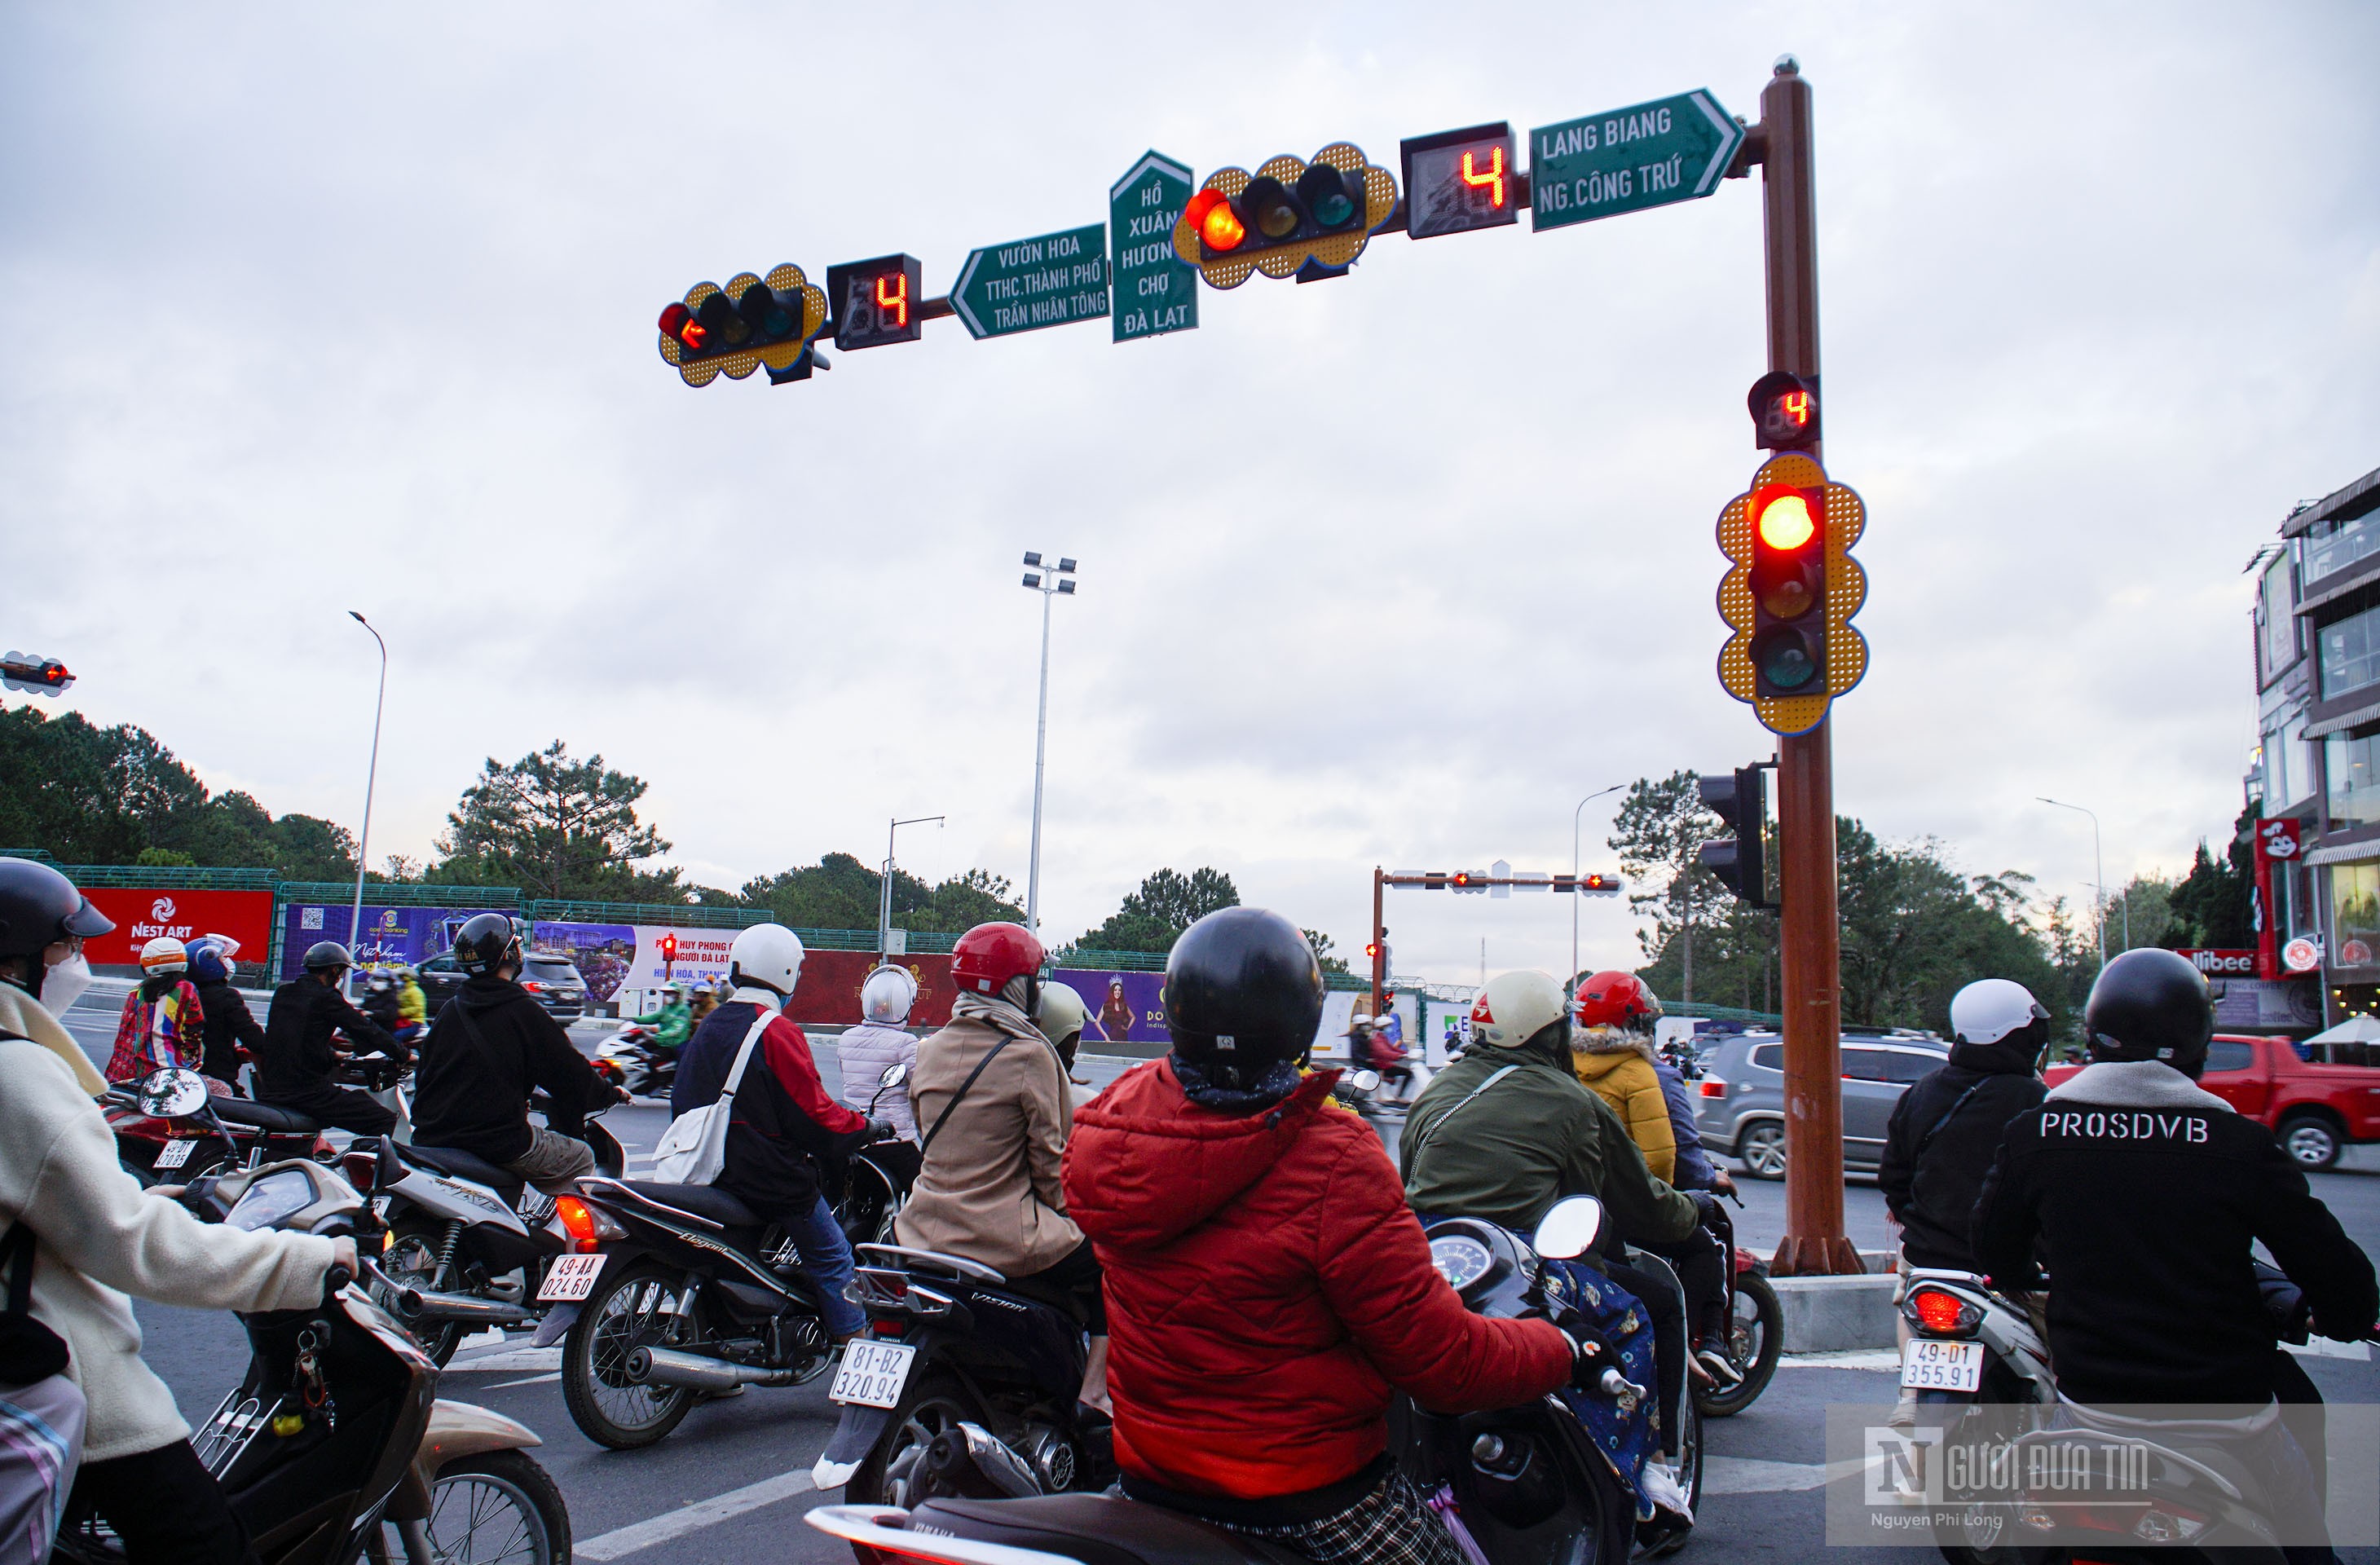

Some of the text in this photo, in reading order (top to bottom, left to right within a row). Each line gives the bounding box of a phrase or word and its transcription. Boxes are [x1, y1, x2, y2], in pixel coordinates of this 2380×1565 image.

[1542, 107, 1672, 160] LANG BIANG
[1461, 145, 1504, 209] 4
[1539, 152, 1683, 214] NG.CÔNG TRỨ
[1141, 179, 1162, 207] HỒ
[1129, 209, 1178, 237] XUÂN
[998, 235, 1081, 269] VƯỜN HOA
[1122, 240, 1173, 269] HƯƠN
[985, 253, 1103, 302] TTHC.THÀNH PHỐ
[1138, 271, 1170, 296] CHỢ
[877, 272, 906, 326] 4
[994, 290, 1106, 329] TRẦN NHÂN TÔNG
[1123, 304, 1188, 333] ĐÀ LẠT
[1785, 390, 1808, 425] 4
[131, 921, 192, 938] NEST ART
[679, 940, 696, 950] HUY
[698, 941, 727, 951] PHONG
[701, 951, 713, 963] ĐÀ
[715, 954, 729, 965] LẠT
[2192, 950, 2252, 972] llibee
[2040, 1112, 2209, 1143] PROSDVB
[678, 1232, 729, 1254] Elegant
[558, 1258, 597, 1276] 49-AA
[971, 1291, 1028, 1312] VISION
[853, 1345, 903, 1375] 81-B2
[1918, 1342, 1970, 1365] 49-D1
[835, 1371, 897, 1404] 320.94
[1907, 1364, 1974, 1387] 355.91
